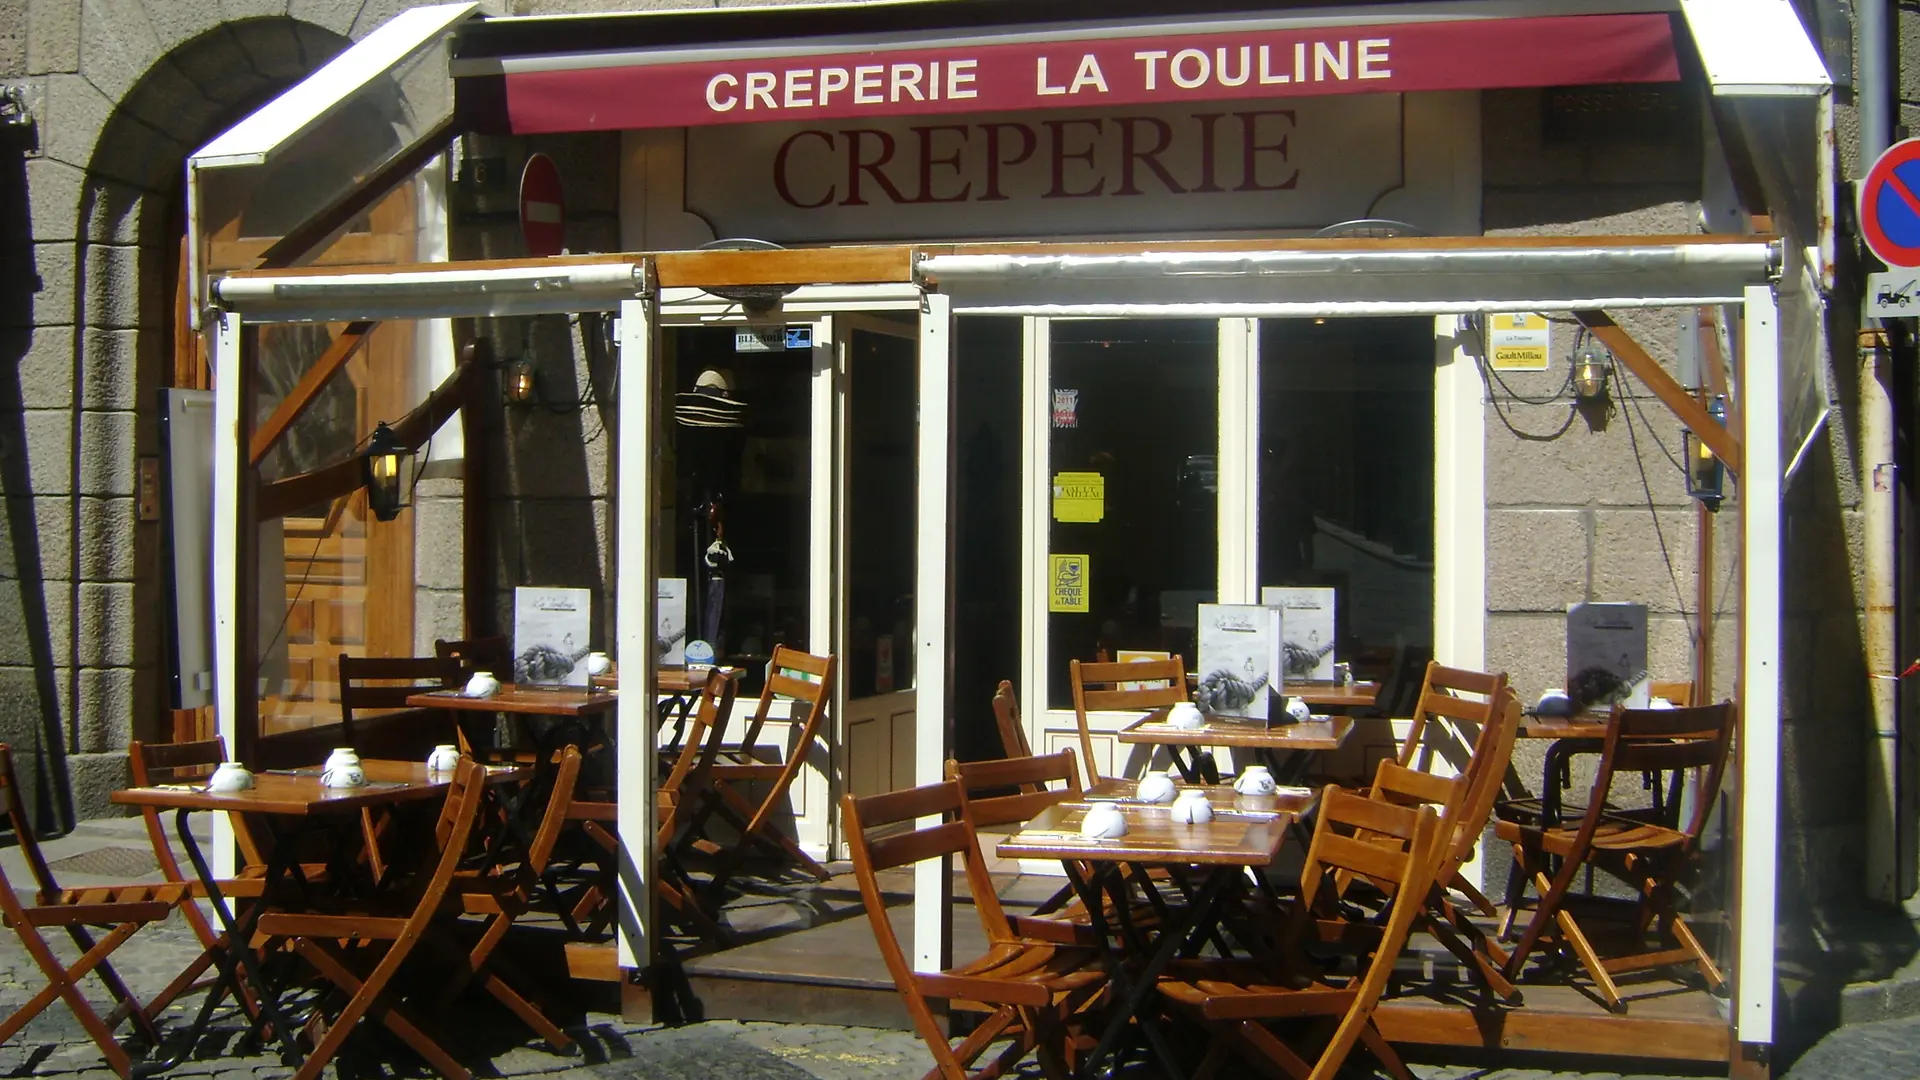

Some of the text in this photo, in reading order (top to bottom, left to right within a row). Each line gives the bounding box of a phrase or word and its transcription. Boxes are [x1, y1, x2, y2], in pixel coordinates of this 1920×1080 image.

[707, 37, 1392, 112] CREPERIE LA TOULINE
[773, 110, 1300, 209] CREPERIE
[1057, 396, 1073, 404] 2011
[1061, 597, 1082, 606] TABLE
